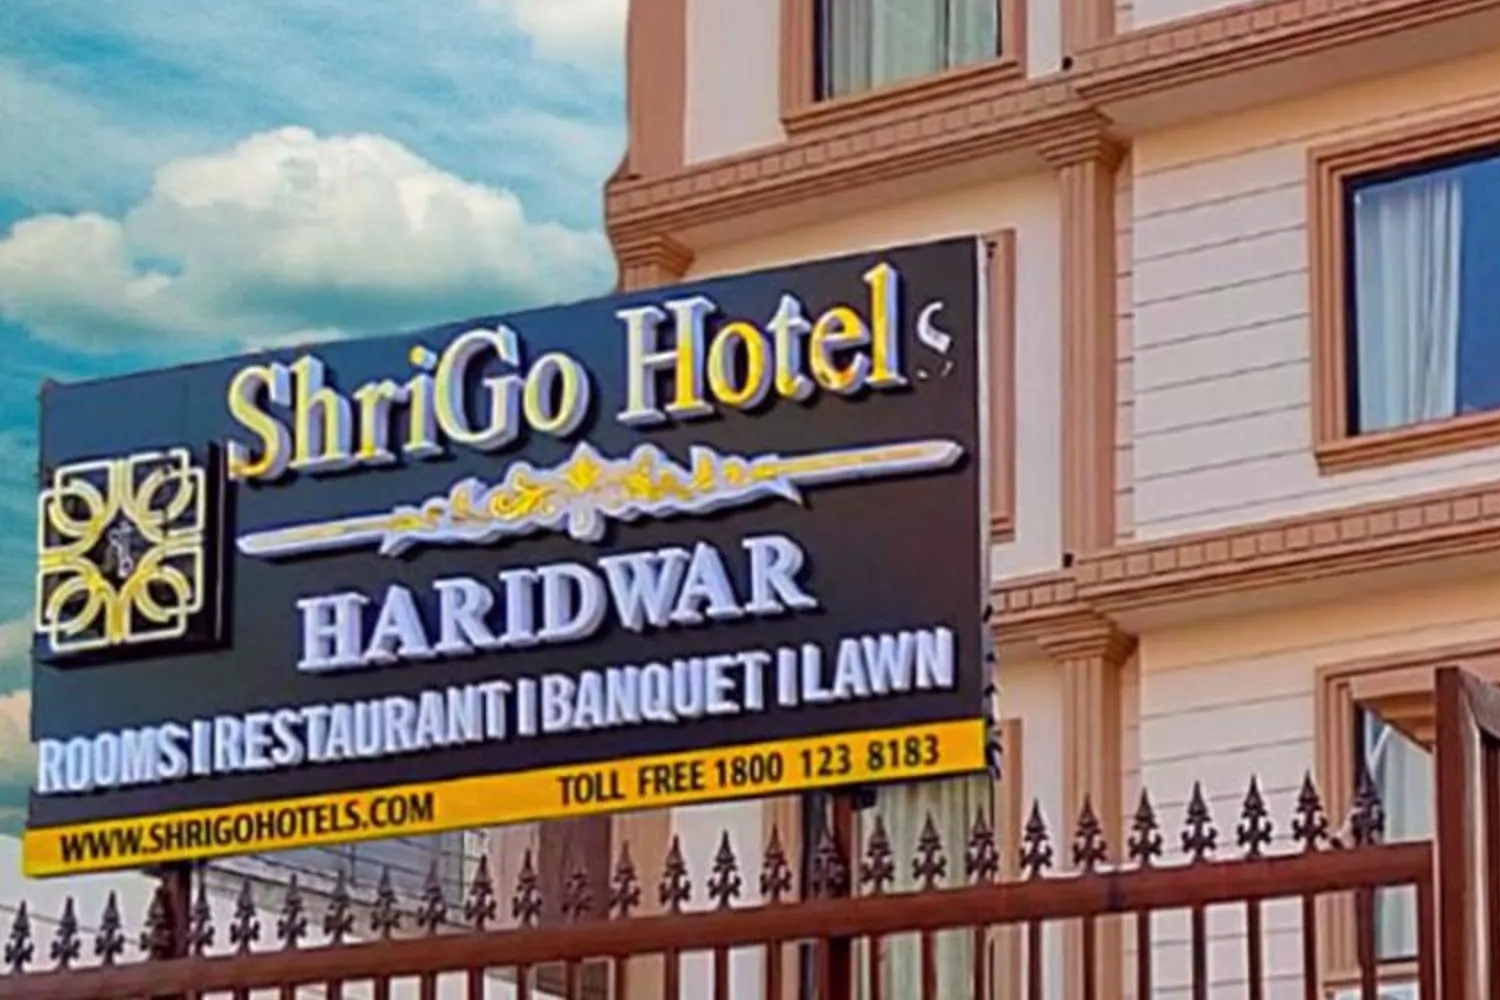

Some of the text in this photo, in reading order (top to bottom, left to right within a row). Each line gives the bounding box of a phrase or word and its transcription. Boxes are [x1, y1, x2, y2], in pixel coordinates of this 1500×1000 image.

[227, 325, 590, 480] ShriGo
[298, 535, 818, 672] HARIDWAR
[37, 722, 189, 793] ROOMS
[213, 680, 511, 772] RESTAURANT
[541, 650, 771, 732] BANQUET
[802, 627, 955, 700] LAWN
[558, 734, 940, 806] TOLL FREE 1800 123 8183
[60, 791, 435, 865] WWW.SHRIGOHOTELS.COM
